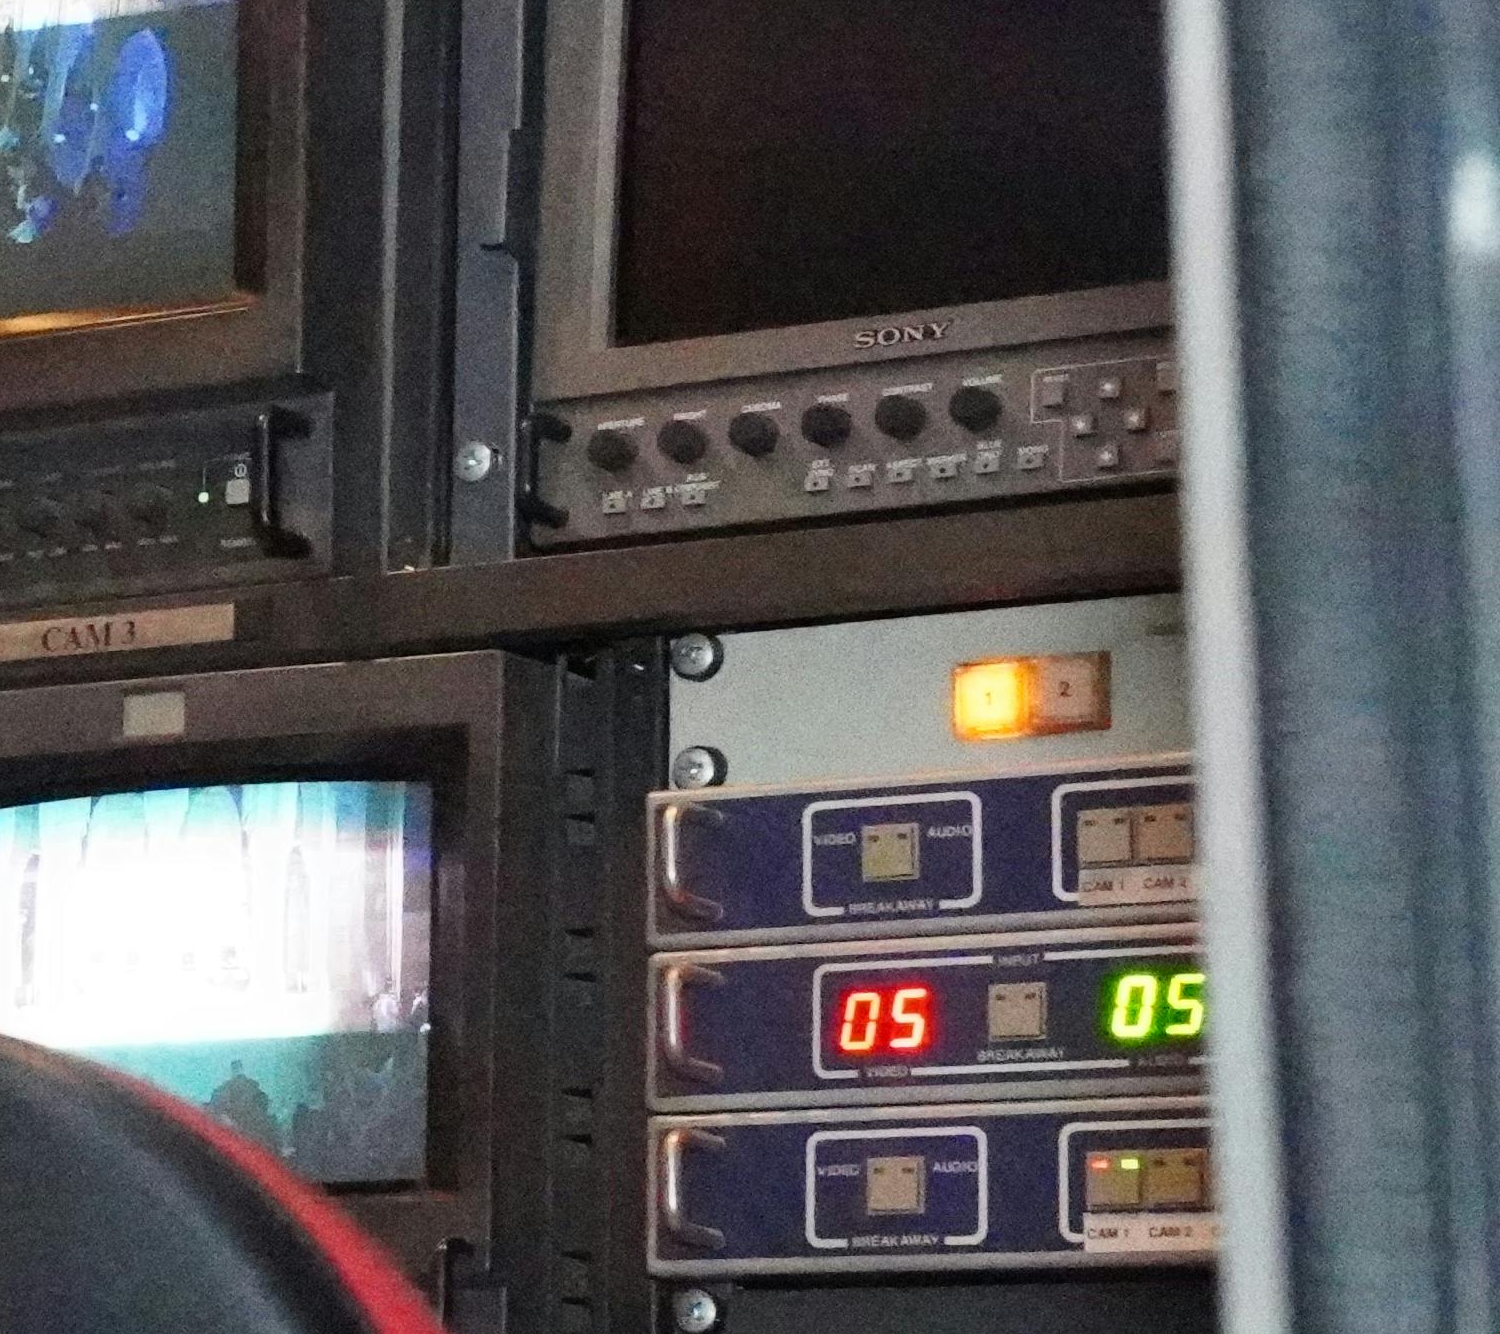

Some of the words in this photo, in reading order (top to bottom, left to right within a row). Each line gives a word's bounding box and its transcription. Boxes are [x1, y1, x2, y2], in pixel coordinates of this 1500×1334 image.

[855, 322, 950, 349] SONY
[40, 620, 113, 653] CAM
[121, 620, 136, 647] 3
[1058, 679, 1072, 699] 2
[814, 831, 857, 846] VIDEO
[927, 825, 972, 839] AUDIO
[1083, 879, 1115, 894] CAM
[1144, 875, 1175, 889] CAM
[848, 899, 935, 916] BREAKAWAY
[1109, 972, 1206, 1038] 05
[838, 987, 928, 1051] 05
[816, 1165, 861, 1178] VIDEO
[932, 1160, 977, 1174] AUDIO
[851, 1234, 940, 1248] BREAKAWAY
[1087, 1226, 1120, 1240] CAM
[1148, 1225, 1183, 1239] CAM
